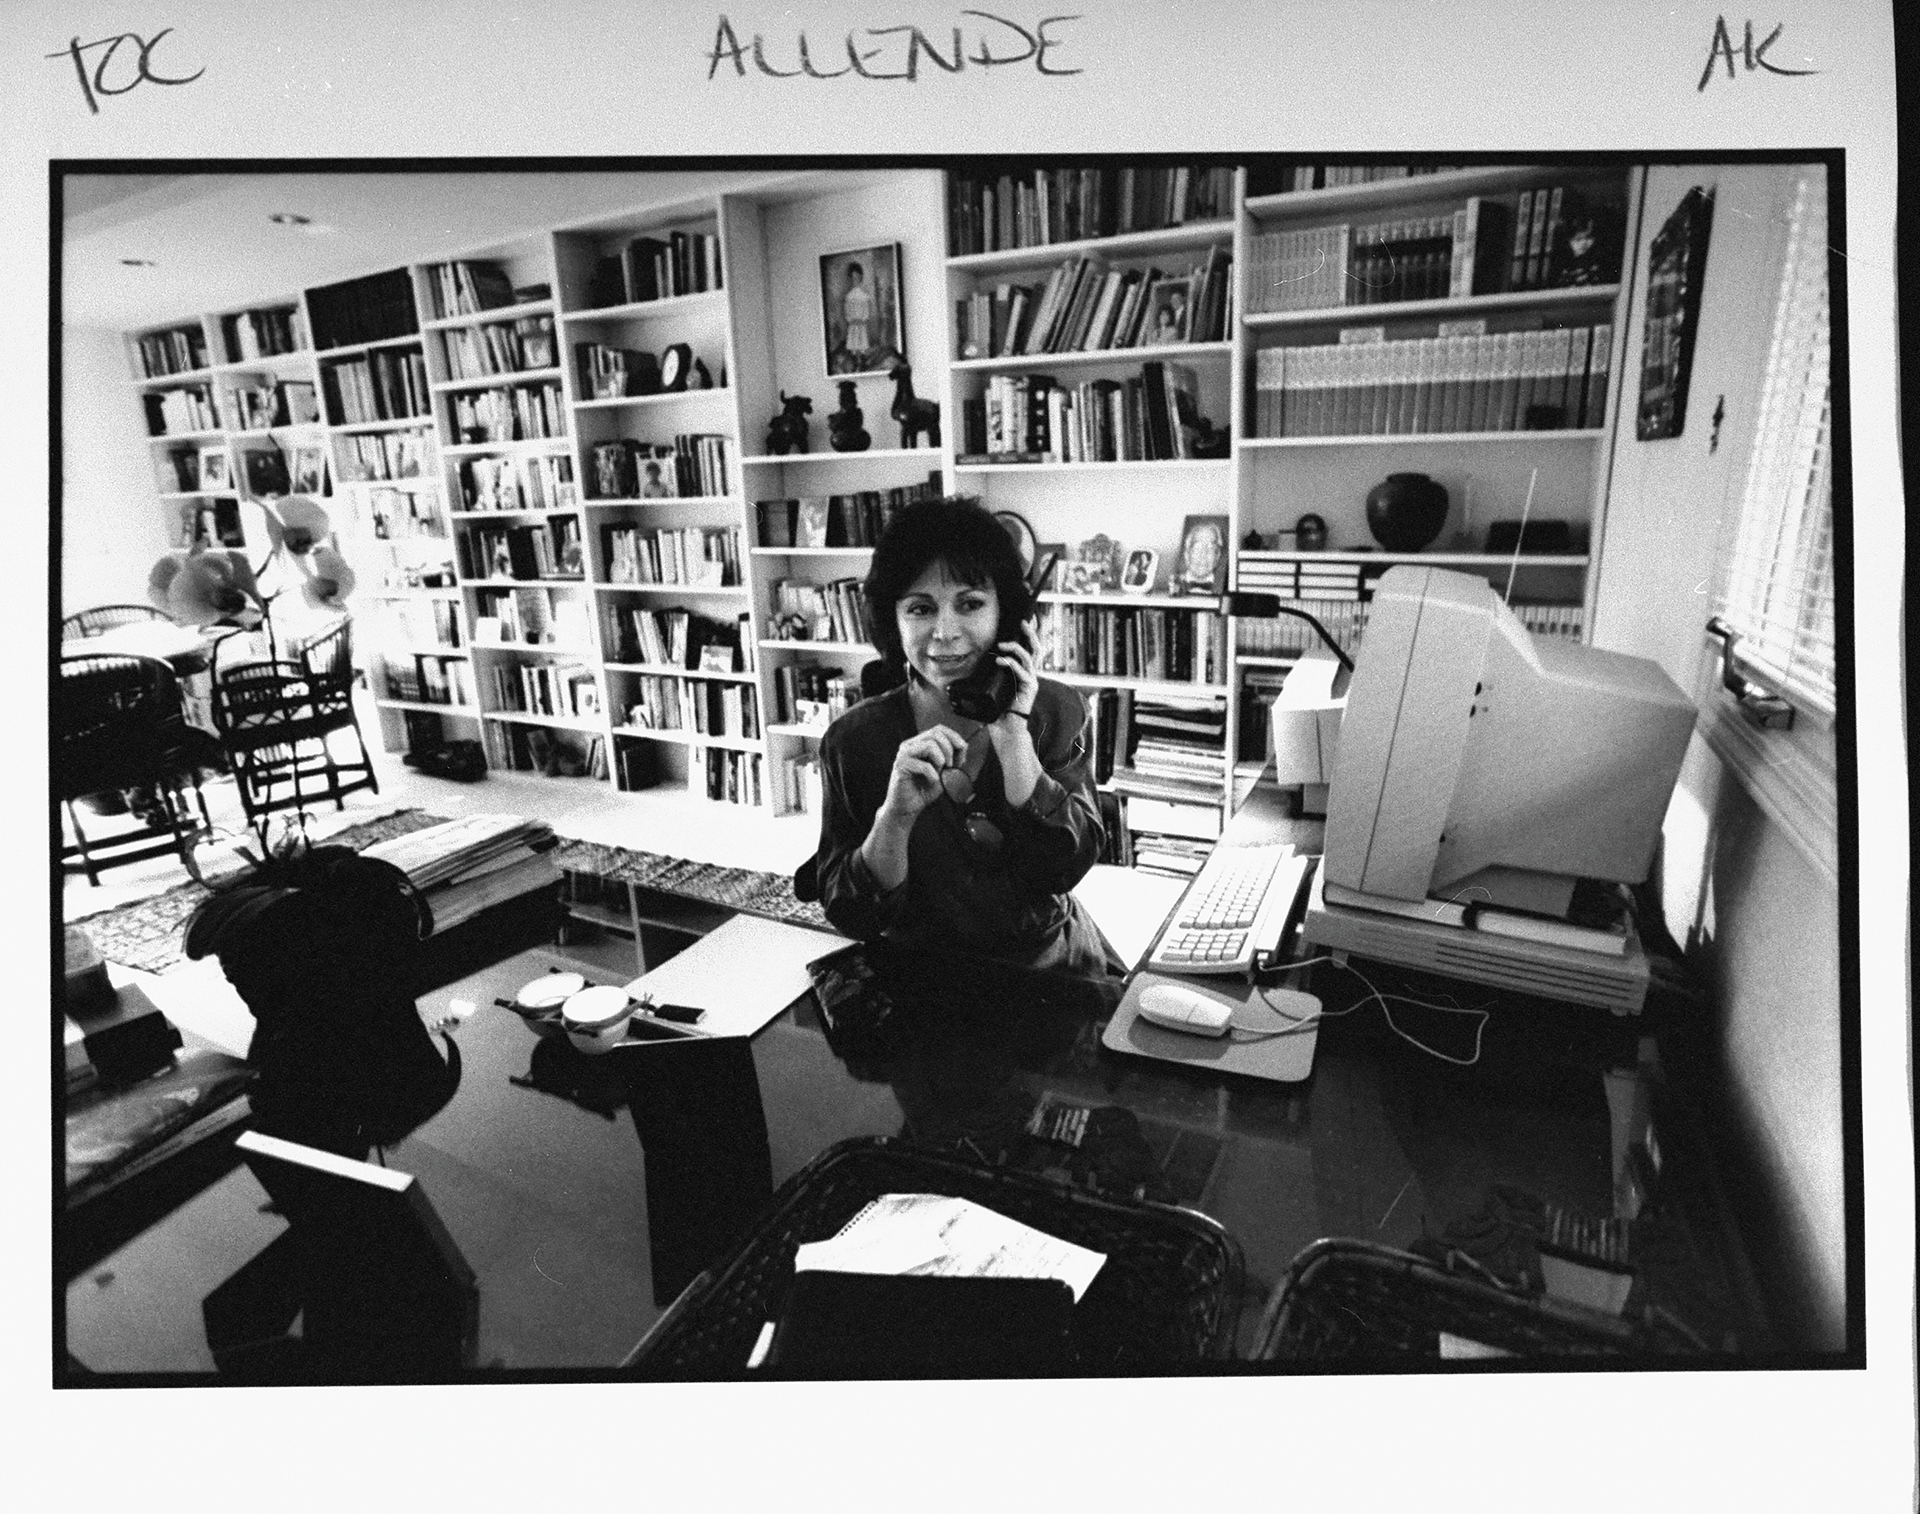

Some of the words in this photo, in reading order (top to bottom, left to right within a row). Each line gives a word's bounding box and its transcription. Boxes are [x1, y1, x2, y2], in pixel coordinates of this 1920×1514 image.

[45, 28, 206, 115] TOC
[706, 10, 1084, 83] ALLENDE
[1697, 14, 1820, 93] AK
